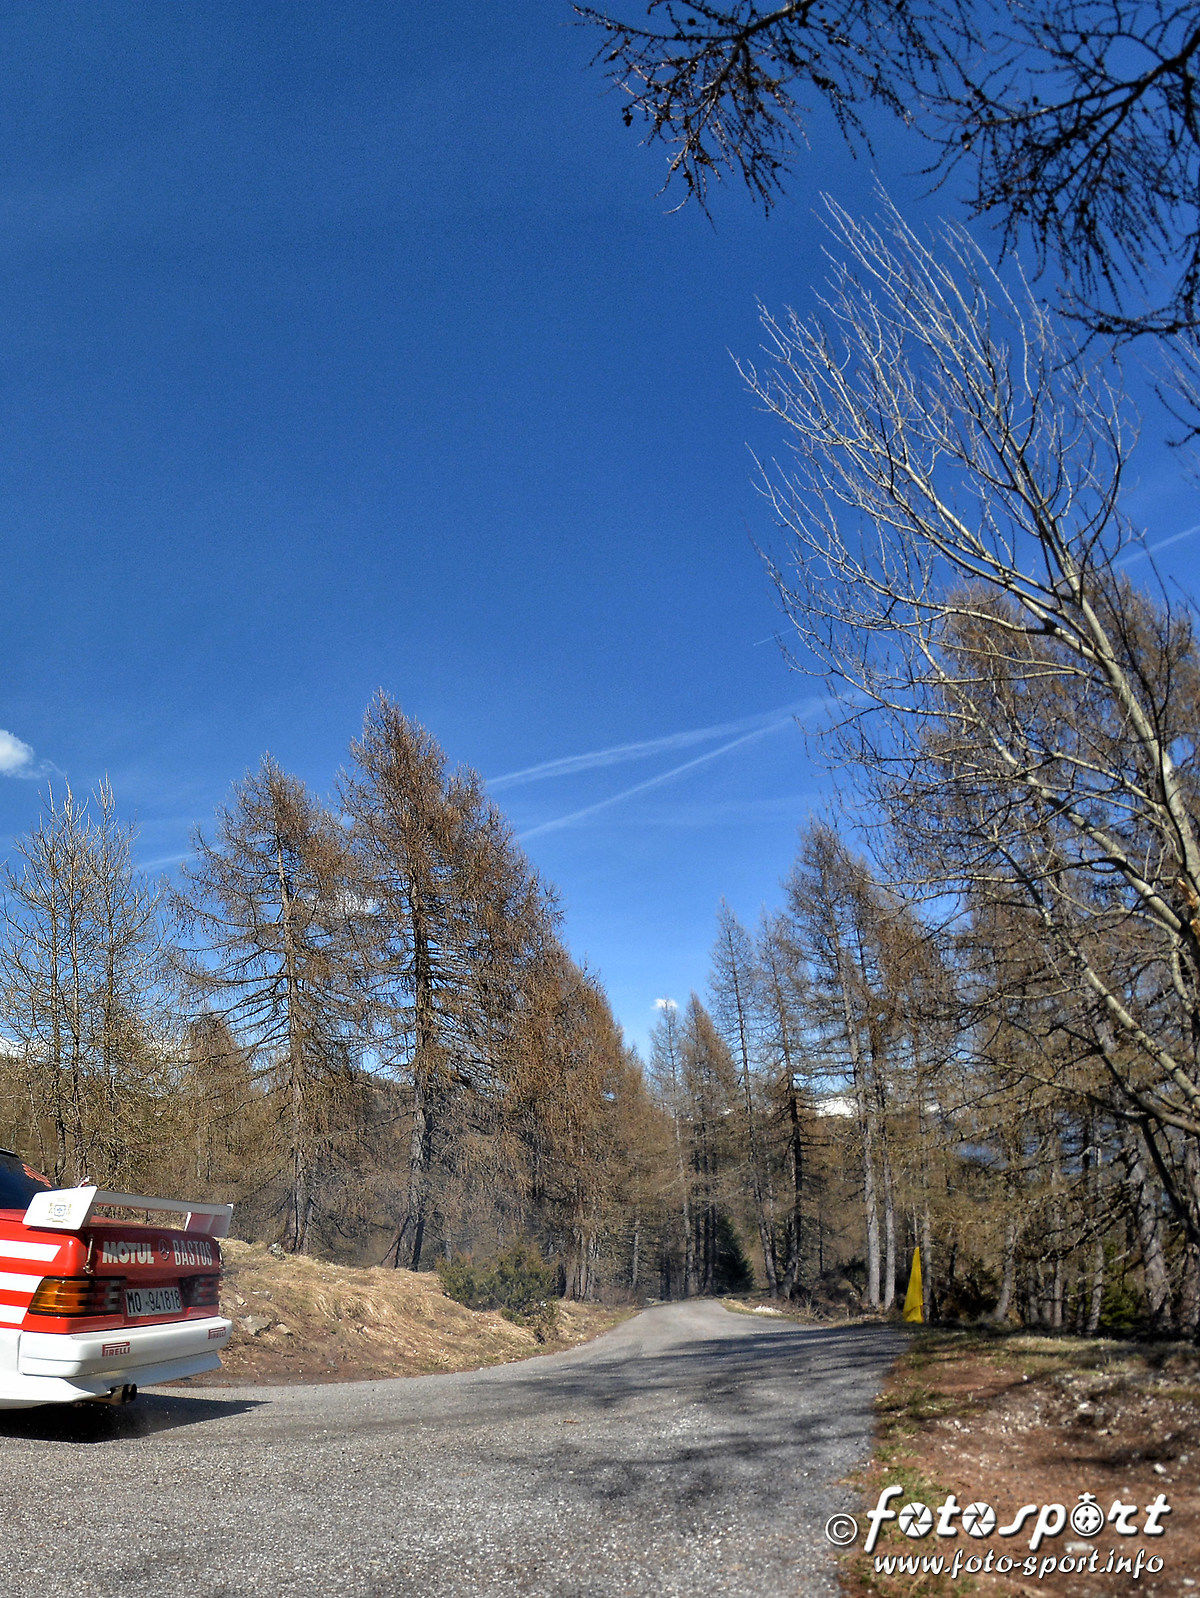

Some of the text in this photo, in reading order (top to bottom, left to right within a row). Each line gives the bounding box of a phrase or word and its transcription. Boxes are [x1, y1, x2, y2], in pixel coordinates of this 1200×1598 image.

[102, 1239, 213, 1267] MOTUL BASTOS
[126, 1291, 142, 1313] MO
[102, 1341, 131, 1357] PIRELLI
